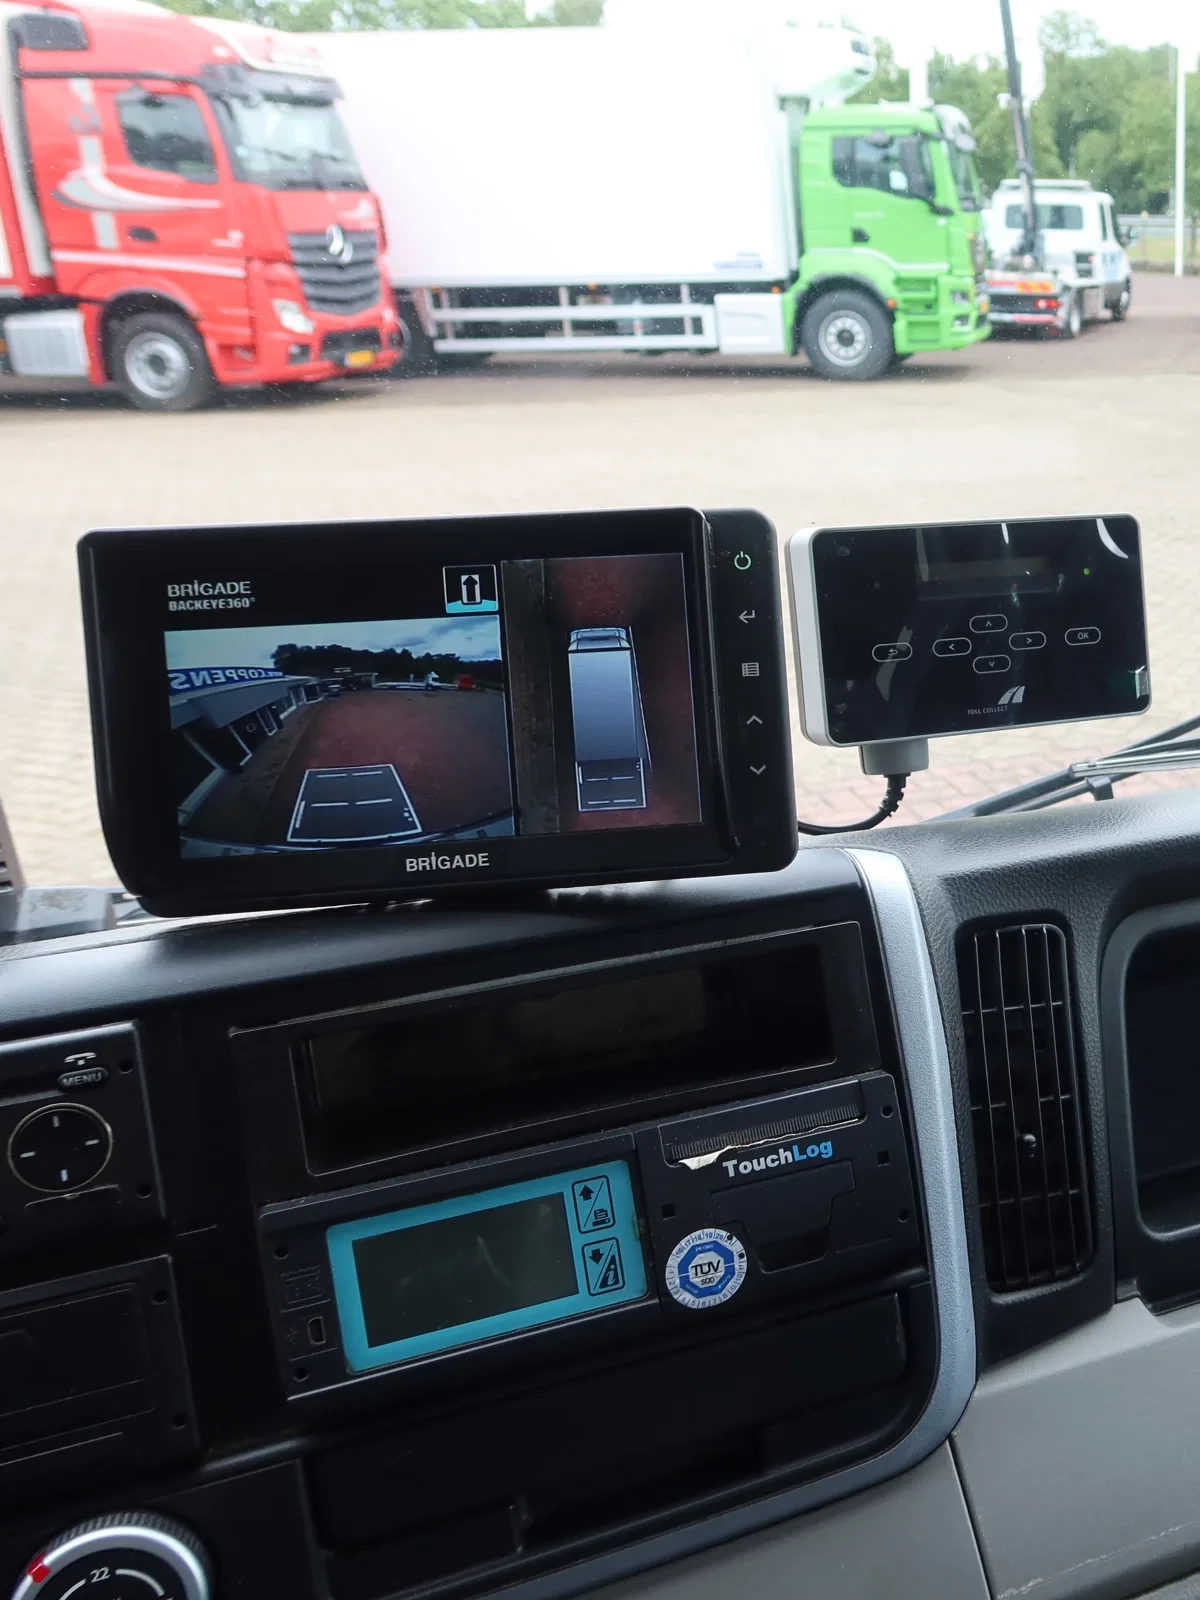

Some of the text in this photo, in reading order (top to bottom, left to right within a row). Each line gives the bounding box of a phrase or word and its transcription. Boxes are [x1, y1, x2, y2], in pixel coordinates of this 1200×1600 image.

[1077, 631, 1089, 640] OK
[967, 705, 1008, 716] TOLL COLLECT
[405, 851, 490, 872] BRIGADE
[62, 1071, 102, 1087] MENU
[722, 1140, 834, 1178] TouchLog
[715, 1232, 724, 1240] 20
[90, 1566, 111, 1583] 22
